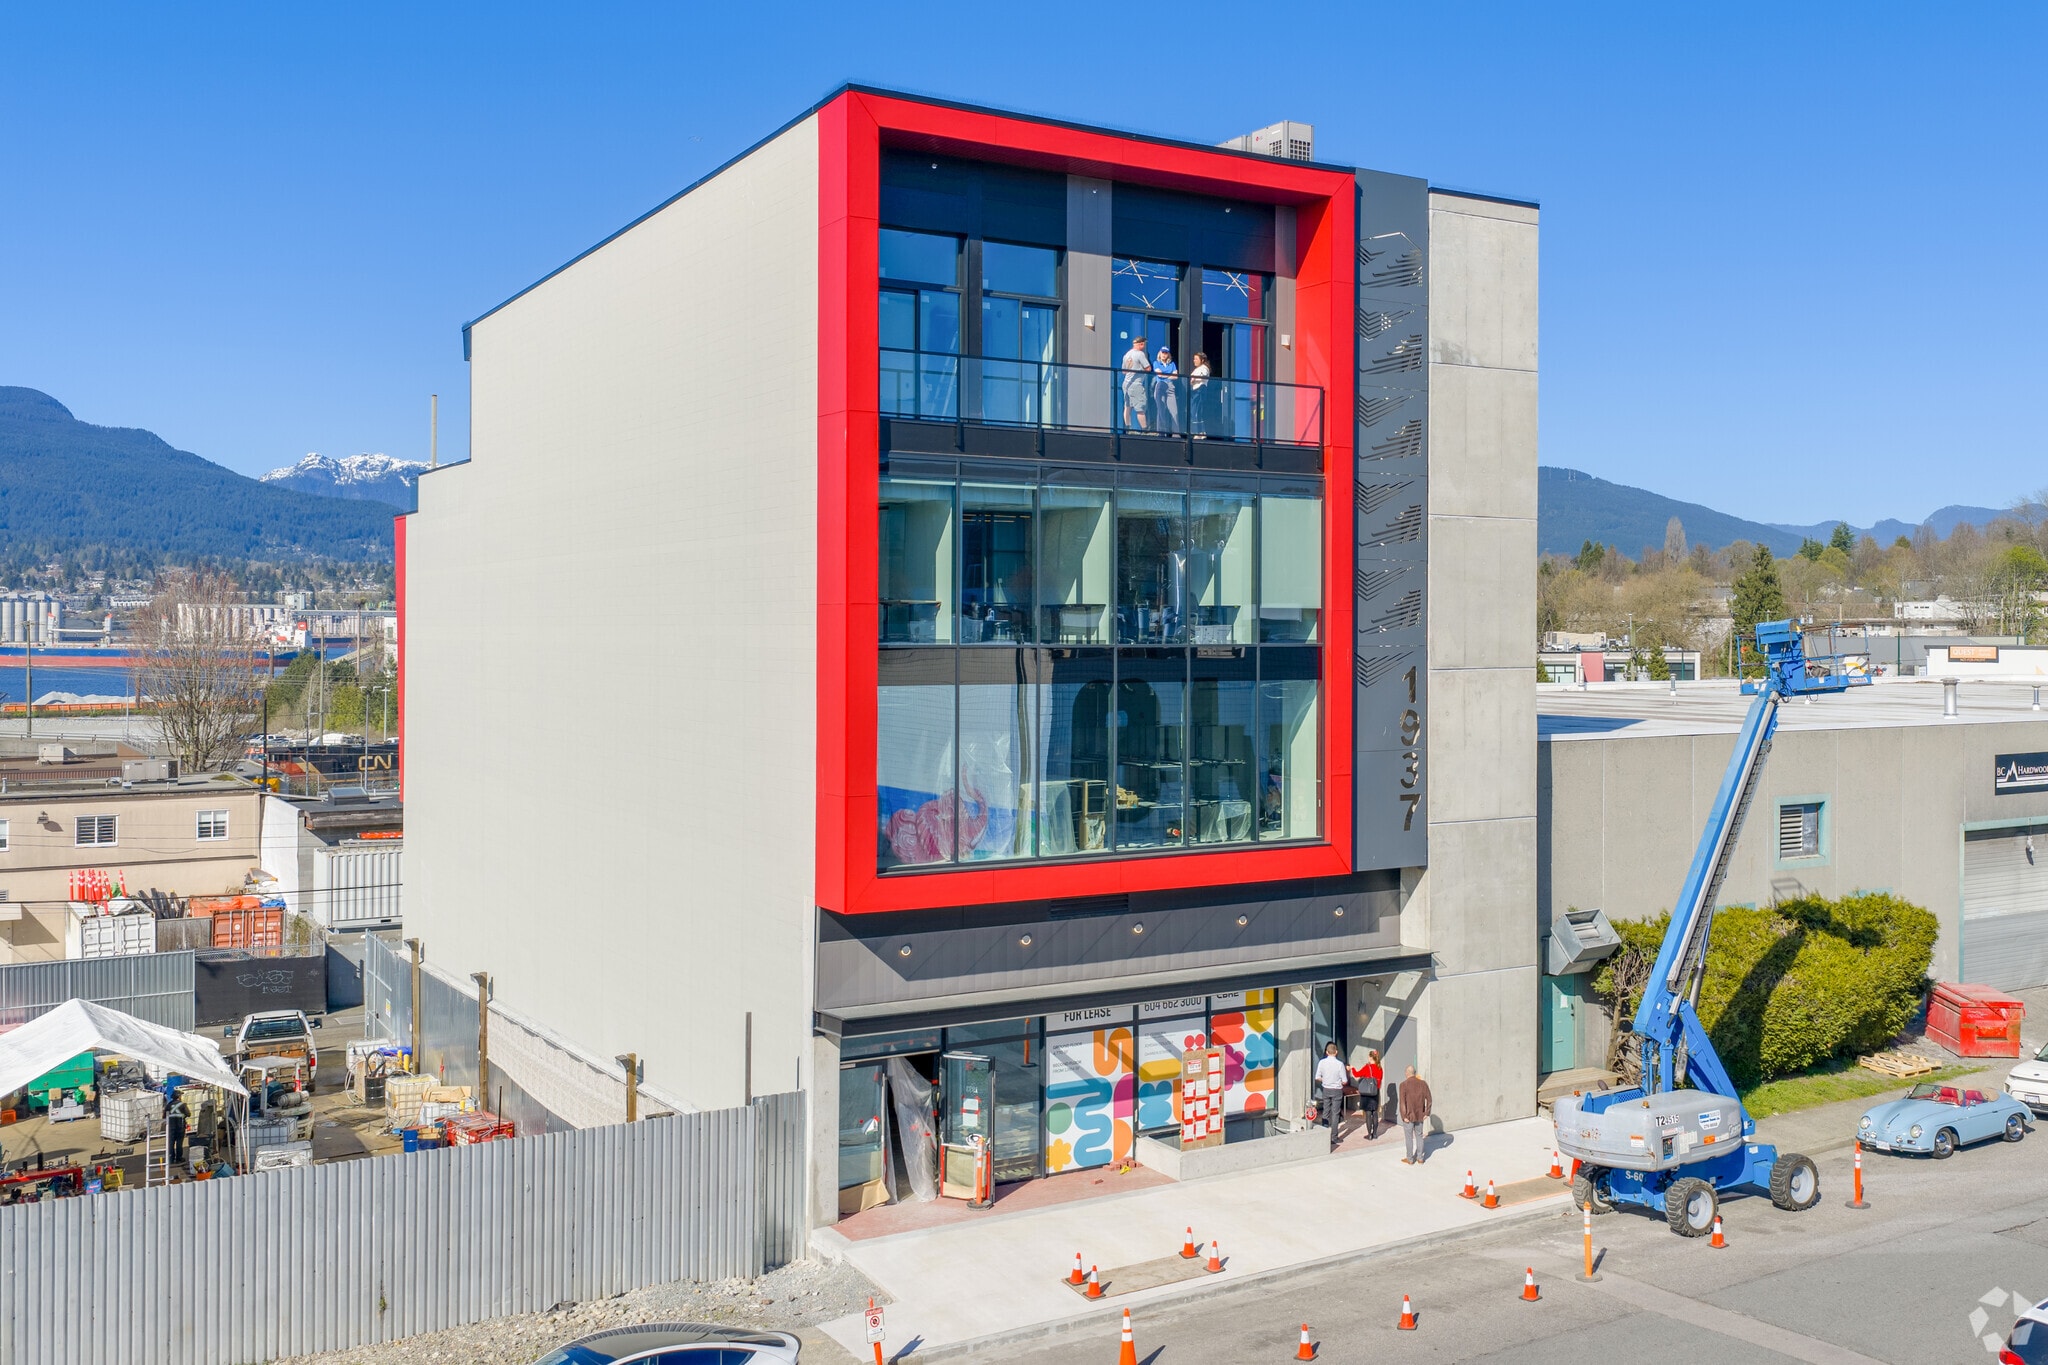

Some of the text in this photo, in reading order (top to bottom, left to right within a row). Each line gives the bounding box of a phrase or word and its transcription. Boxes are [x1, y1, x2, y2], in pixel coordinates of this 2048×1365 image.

[1952, 648, 1975, 656] QUEST
[1400, 665, 1422, 831] 1937
[358, 754, 391, 771] CN
[1996, 766, 2006, 776] BC
[1144, 996, 1202, 1012] 604 662 3000
[1064, 1007, 1111, 1022] FOR LEASE
[1625, 1170, 1644, 1182] S-60
